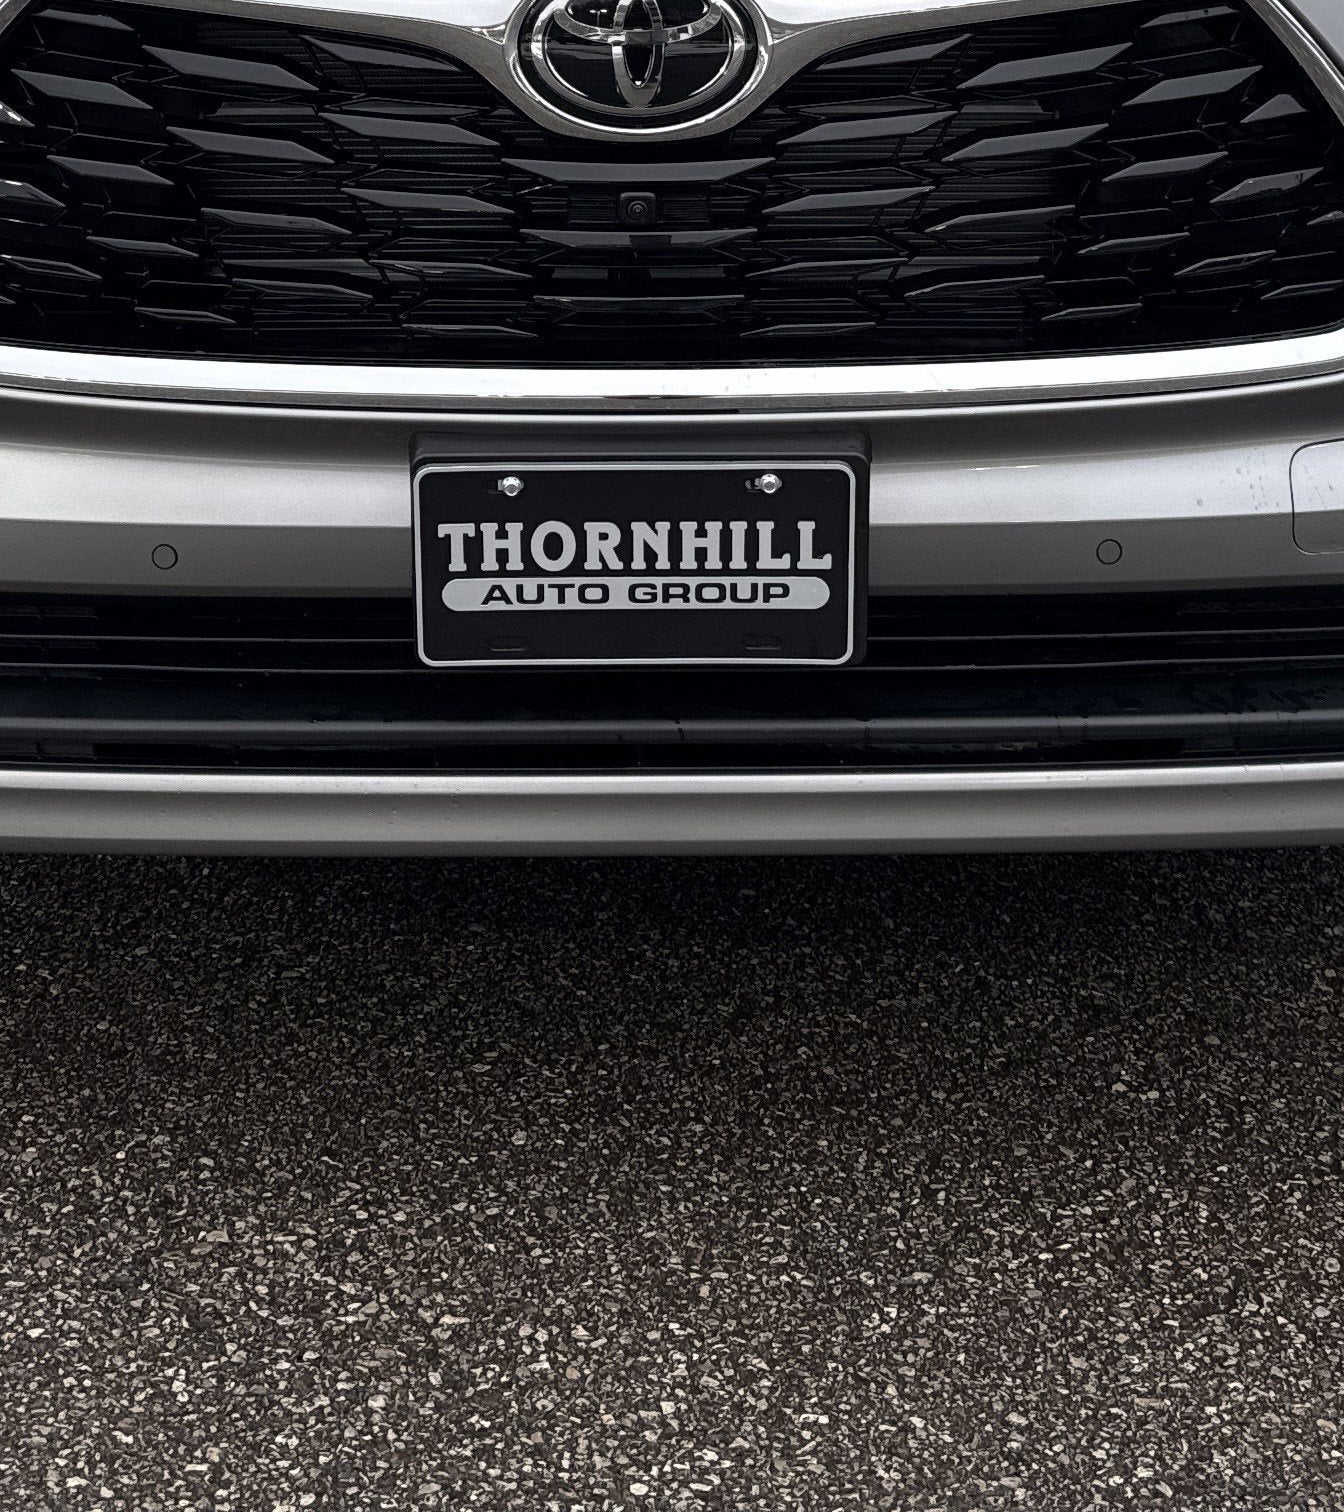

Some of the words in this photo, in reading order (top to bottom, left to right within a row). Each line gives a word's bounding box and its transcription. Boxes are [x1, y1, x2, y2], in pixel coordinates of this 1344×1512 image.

[437, 520, 833, 572] THORNHILL
[480, 583, 611, 606] AUTO
[627, 582, 791, 605] GROUP
